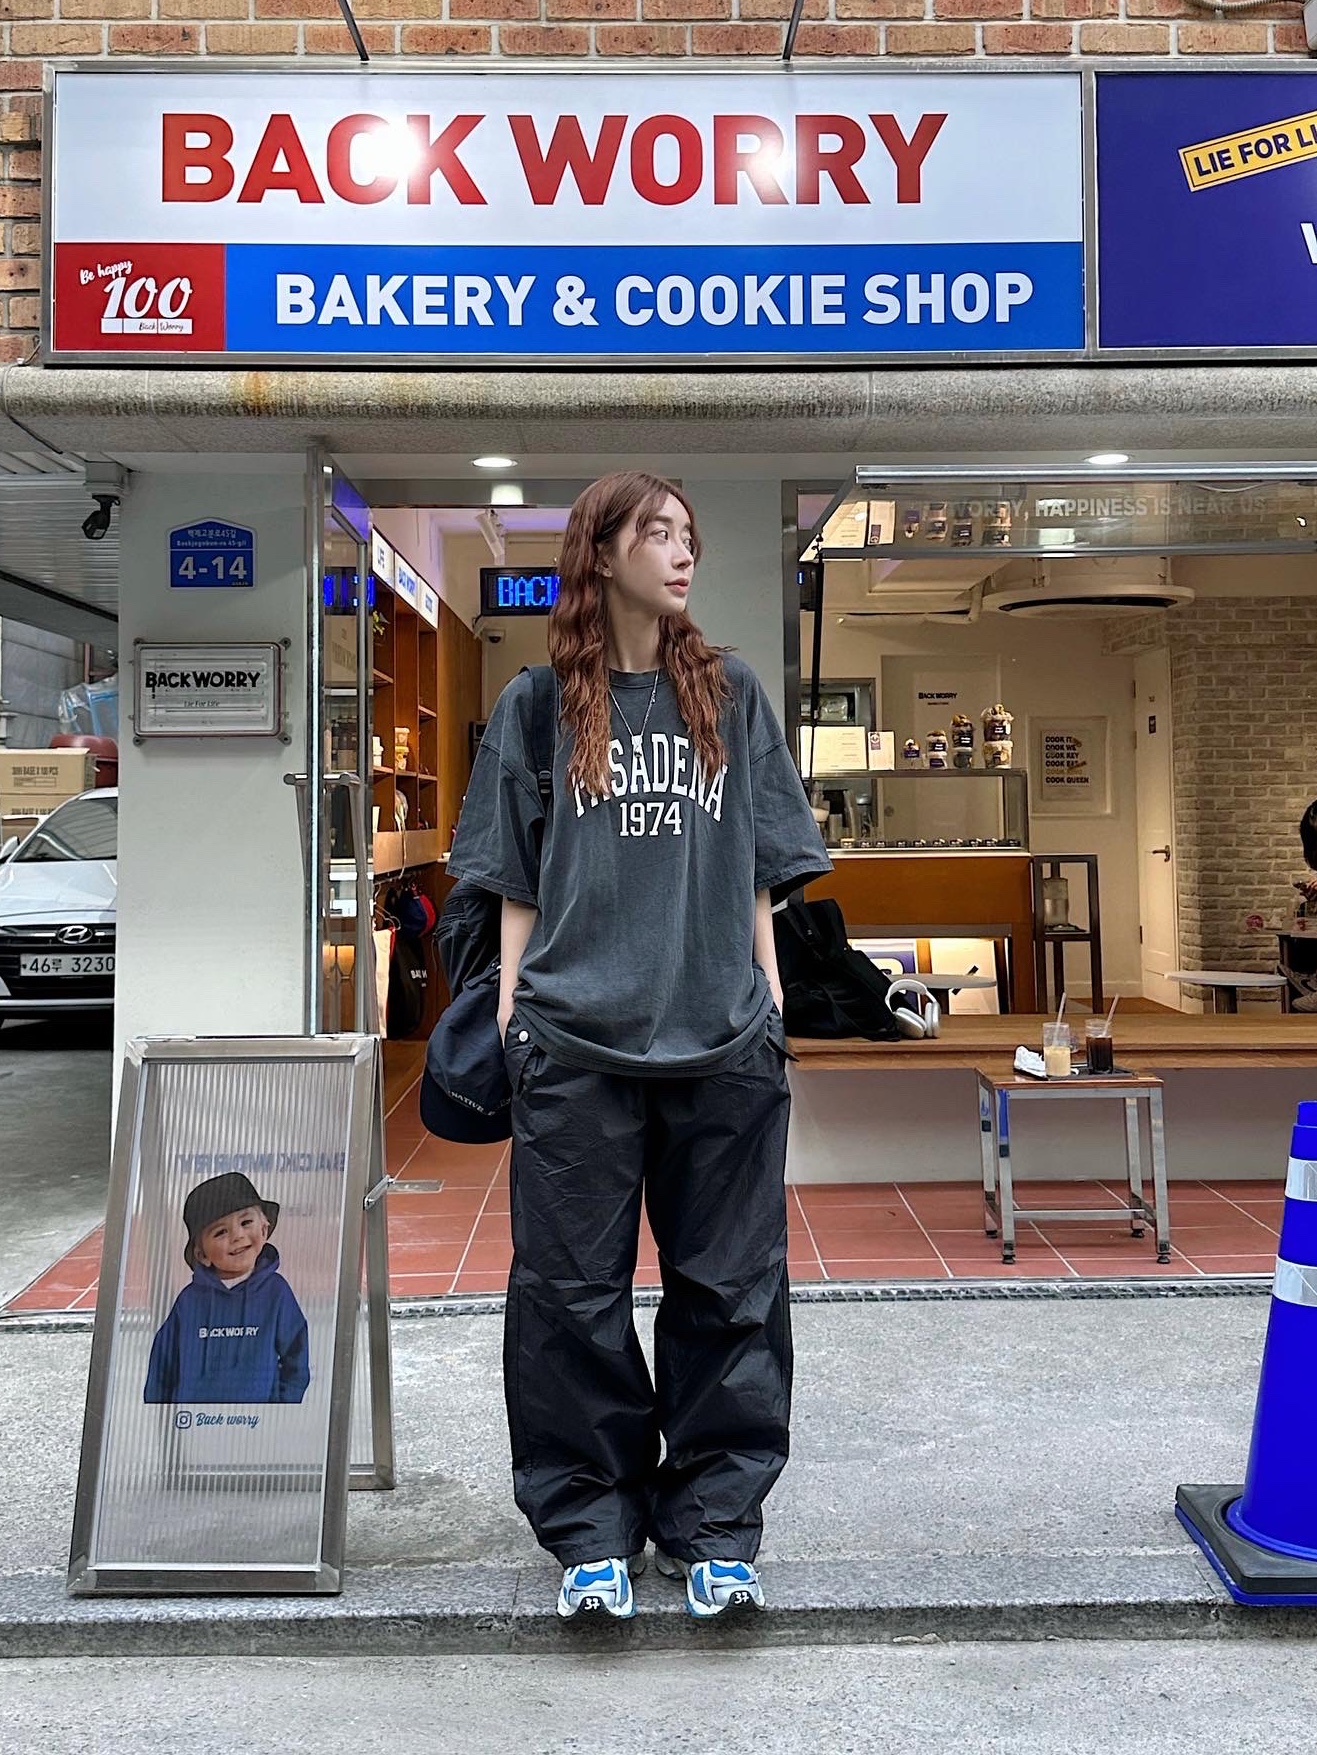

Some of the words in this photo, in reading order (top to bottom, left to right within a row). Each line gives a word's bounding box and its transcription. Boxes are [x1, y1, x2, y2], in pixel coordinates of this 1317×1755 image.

[162, 113, 489, 205] BACK
[508, 113, 949, 207] WORRY
[1193, 147, 1235, 177] LIE
[1237, 132, 1292, 165] FOR
[80, 269, 95, 285] Be
[97, 260, 133, 279] happy
[103, 276, 193, 318] 100
[276, 274, 537, 327] BAKERY
[552, 275, 599, 327] &
[616, 274, 846, 327] COOKIE
[863, 272, 1035, 325] SHOP
[139, 321, 156, 331] Back
[160, 321, 184, 332] Worry
[1035, 498, 1147, 518] HAPPINESS
[1153, 498, 1170, 516] IS
[178, 556, 247, 580] 4-14
[619, 801, 683, 837] 1974
[71, 956, 115, 972] 3230
[195, 1413, 224, 1427] Back
[226, 1414, 259, 1429] worry
